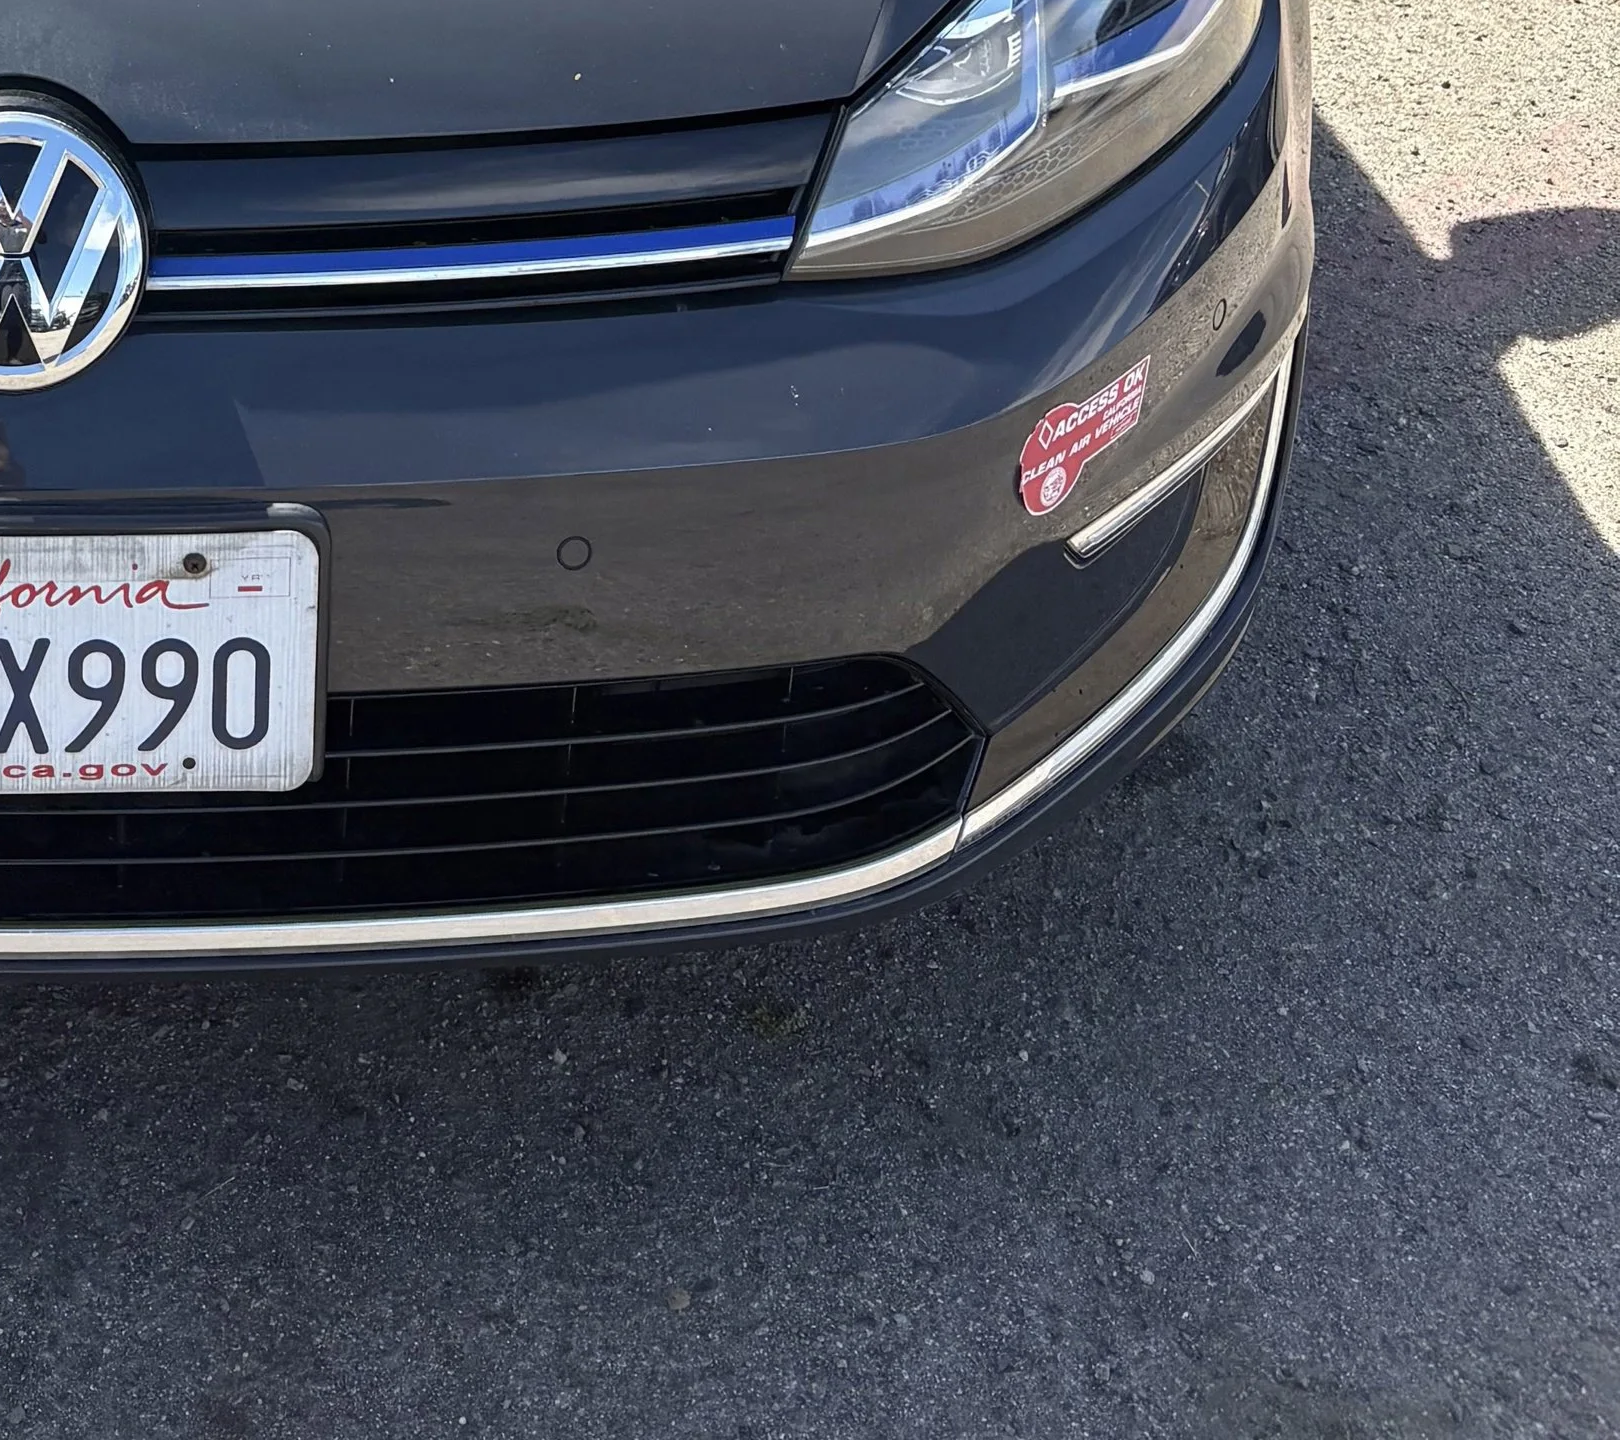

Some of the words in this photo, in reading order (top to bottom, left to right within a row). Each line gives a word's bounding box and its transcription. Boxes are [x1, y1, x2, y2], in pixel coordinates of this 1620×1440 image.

[1021, 449, 1067, 486] CLEAN
[1068, 434, 1091, 459] AIR
[1094, 396, 1141, 439] VEHICLE
[1052, 383, 1120, 442] ACCESS
[1124, 364, 1144, 393] OK
[1102, 384, 1142, 422] CALIFORNIA
